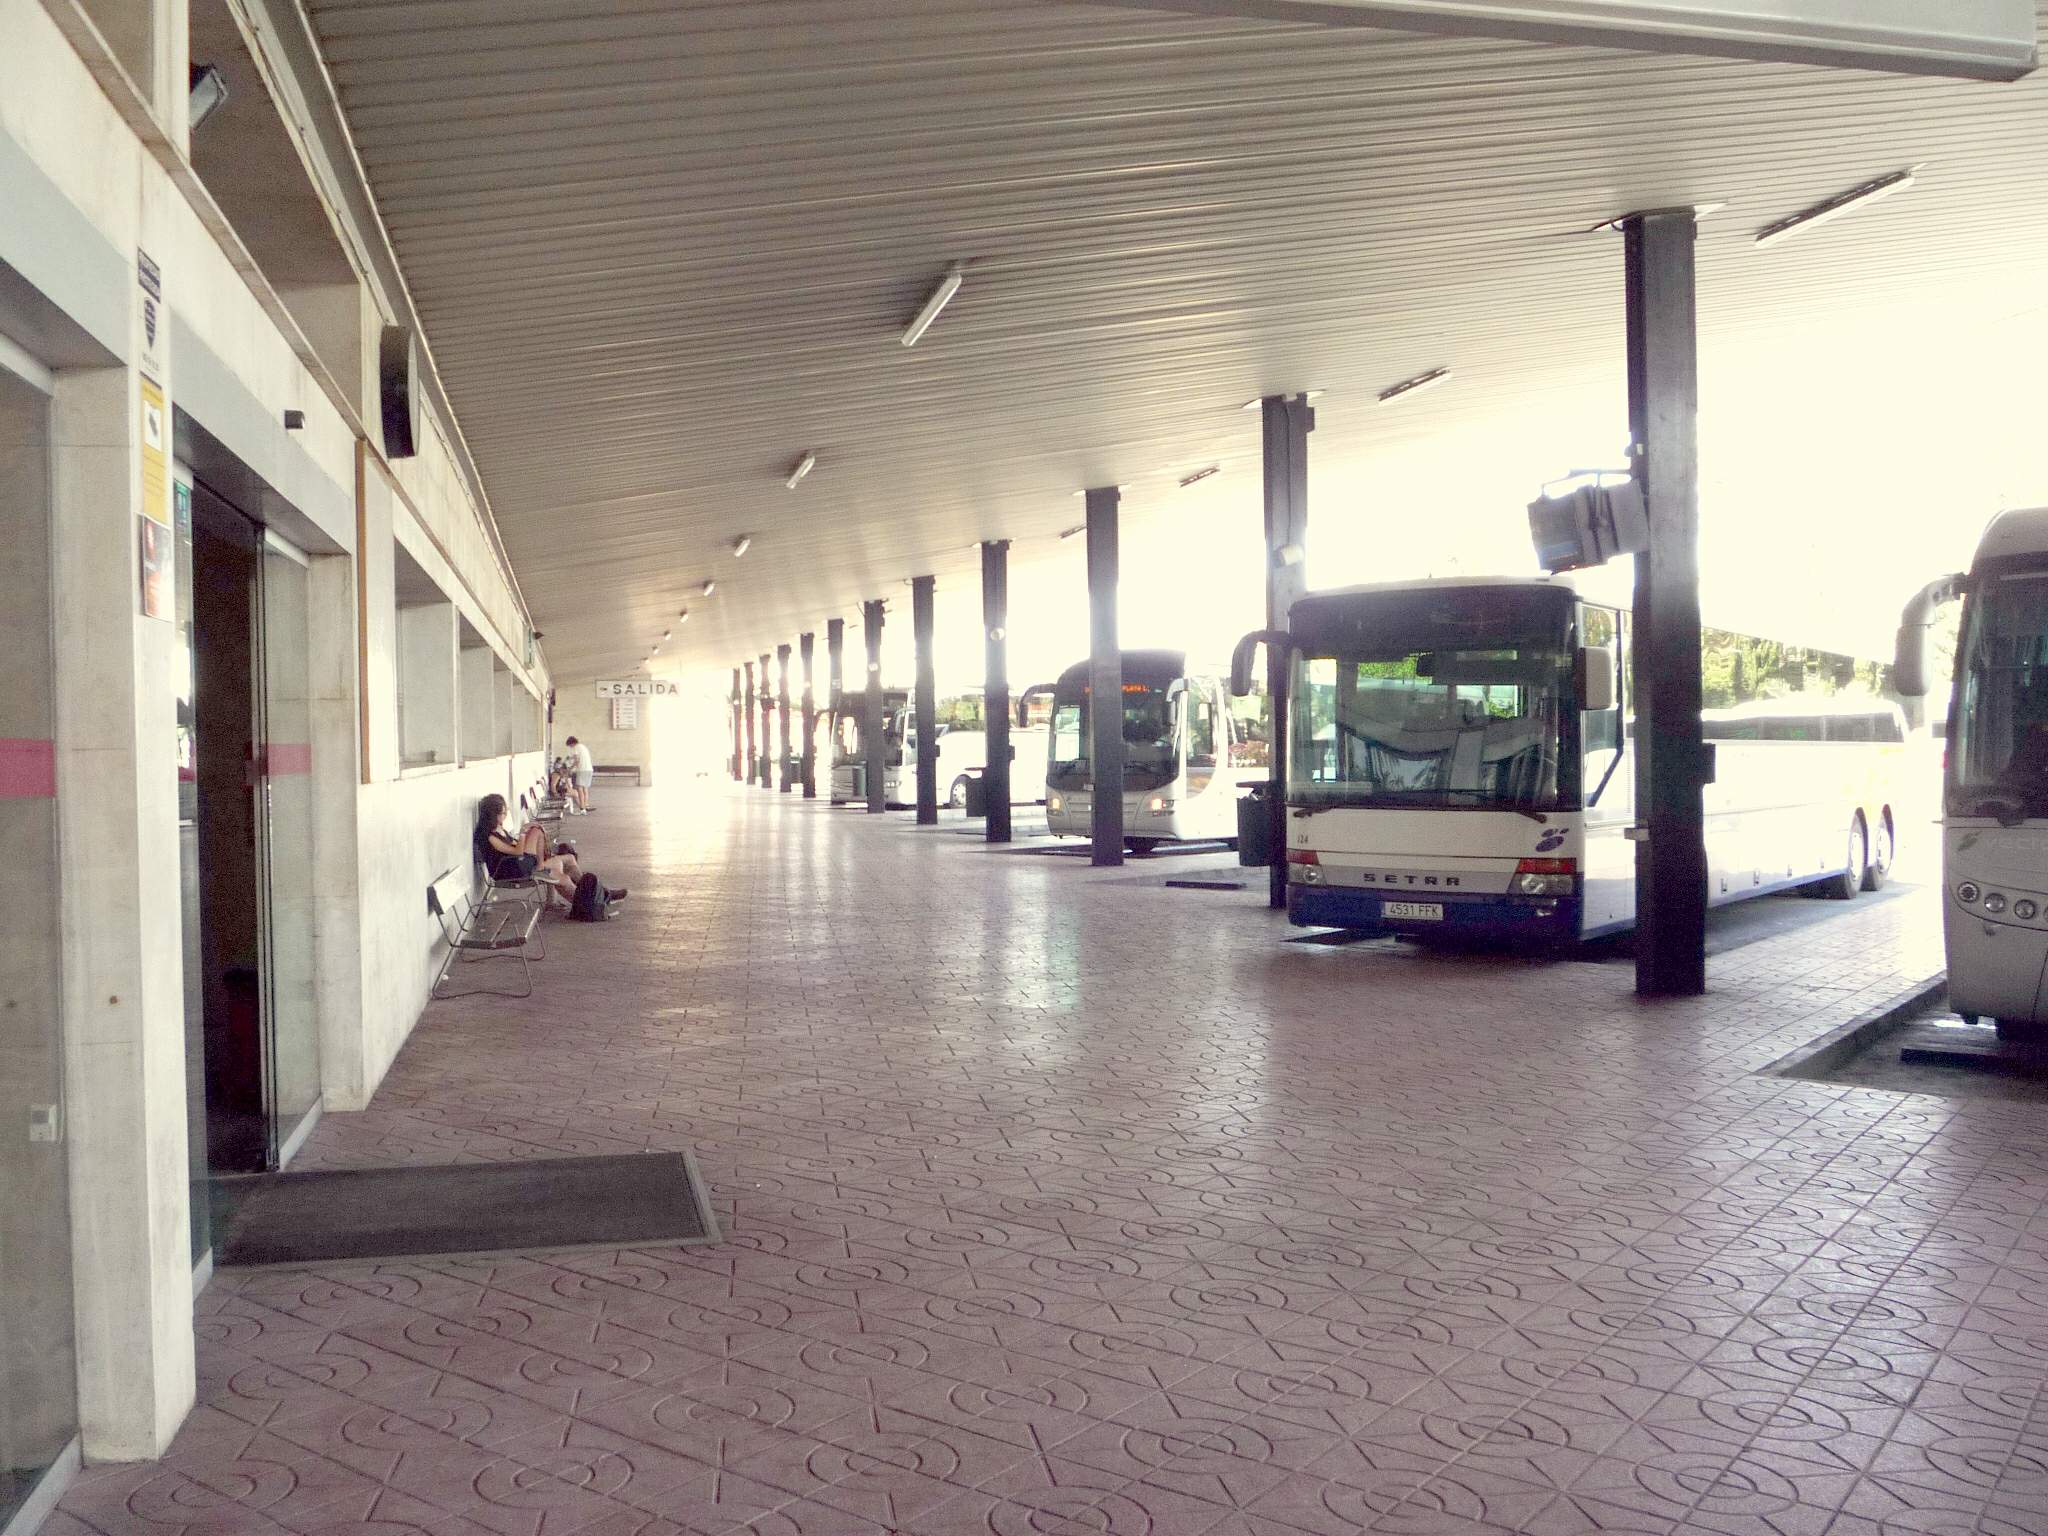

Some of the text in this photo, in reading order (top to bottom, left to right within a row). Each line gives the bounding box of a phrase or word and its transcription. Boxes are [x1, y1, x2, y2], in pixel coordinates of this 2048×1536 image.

[613, 683, 678, 695] SALIDA
[1363, 873, 1460, 886] SETRA
[1390, 903, 1439, 917] 4531 FFK
